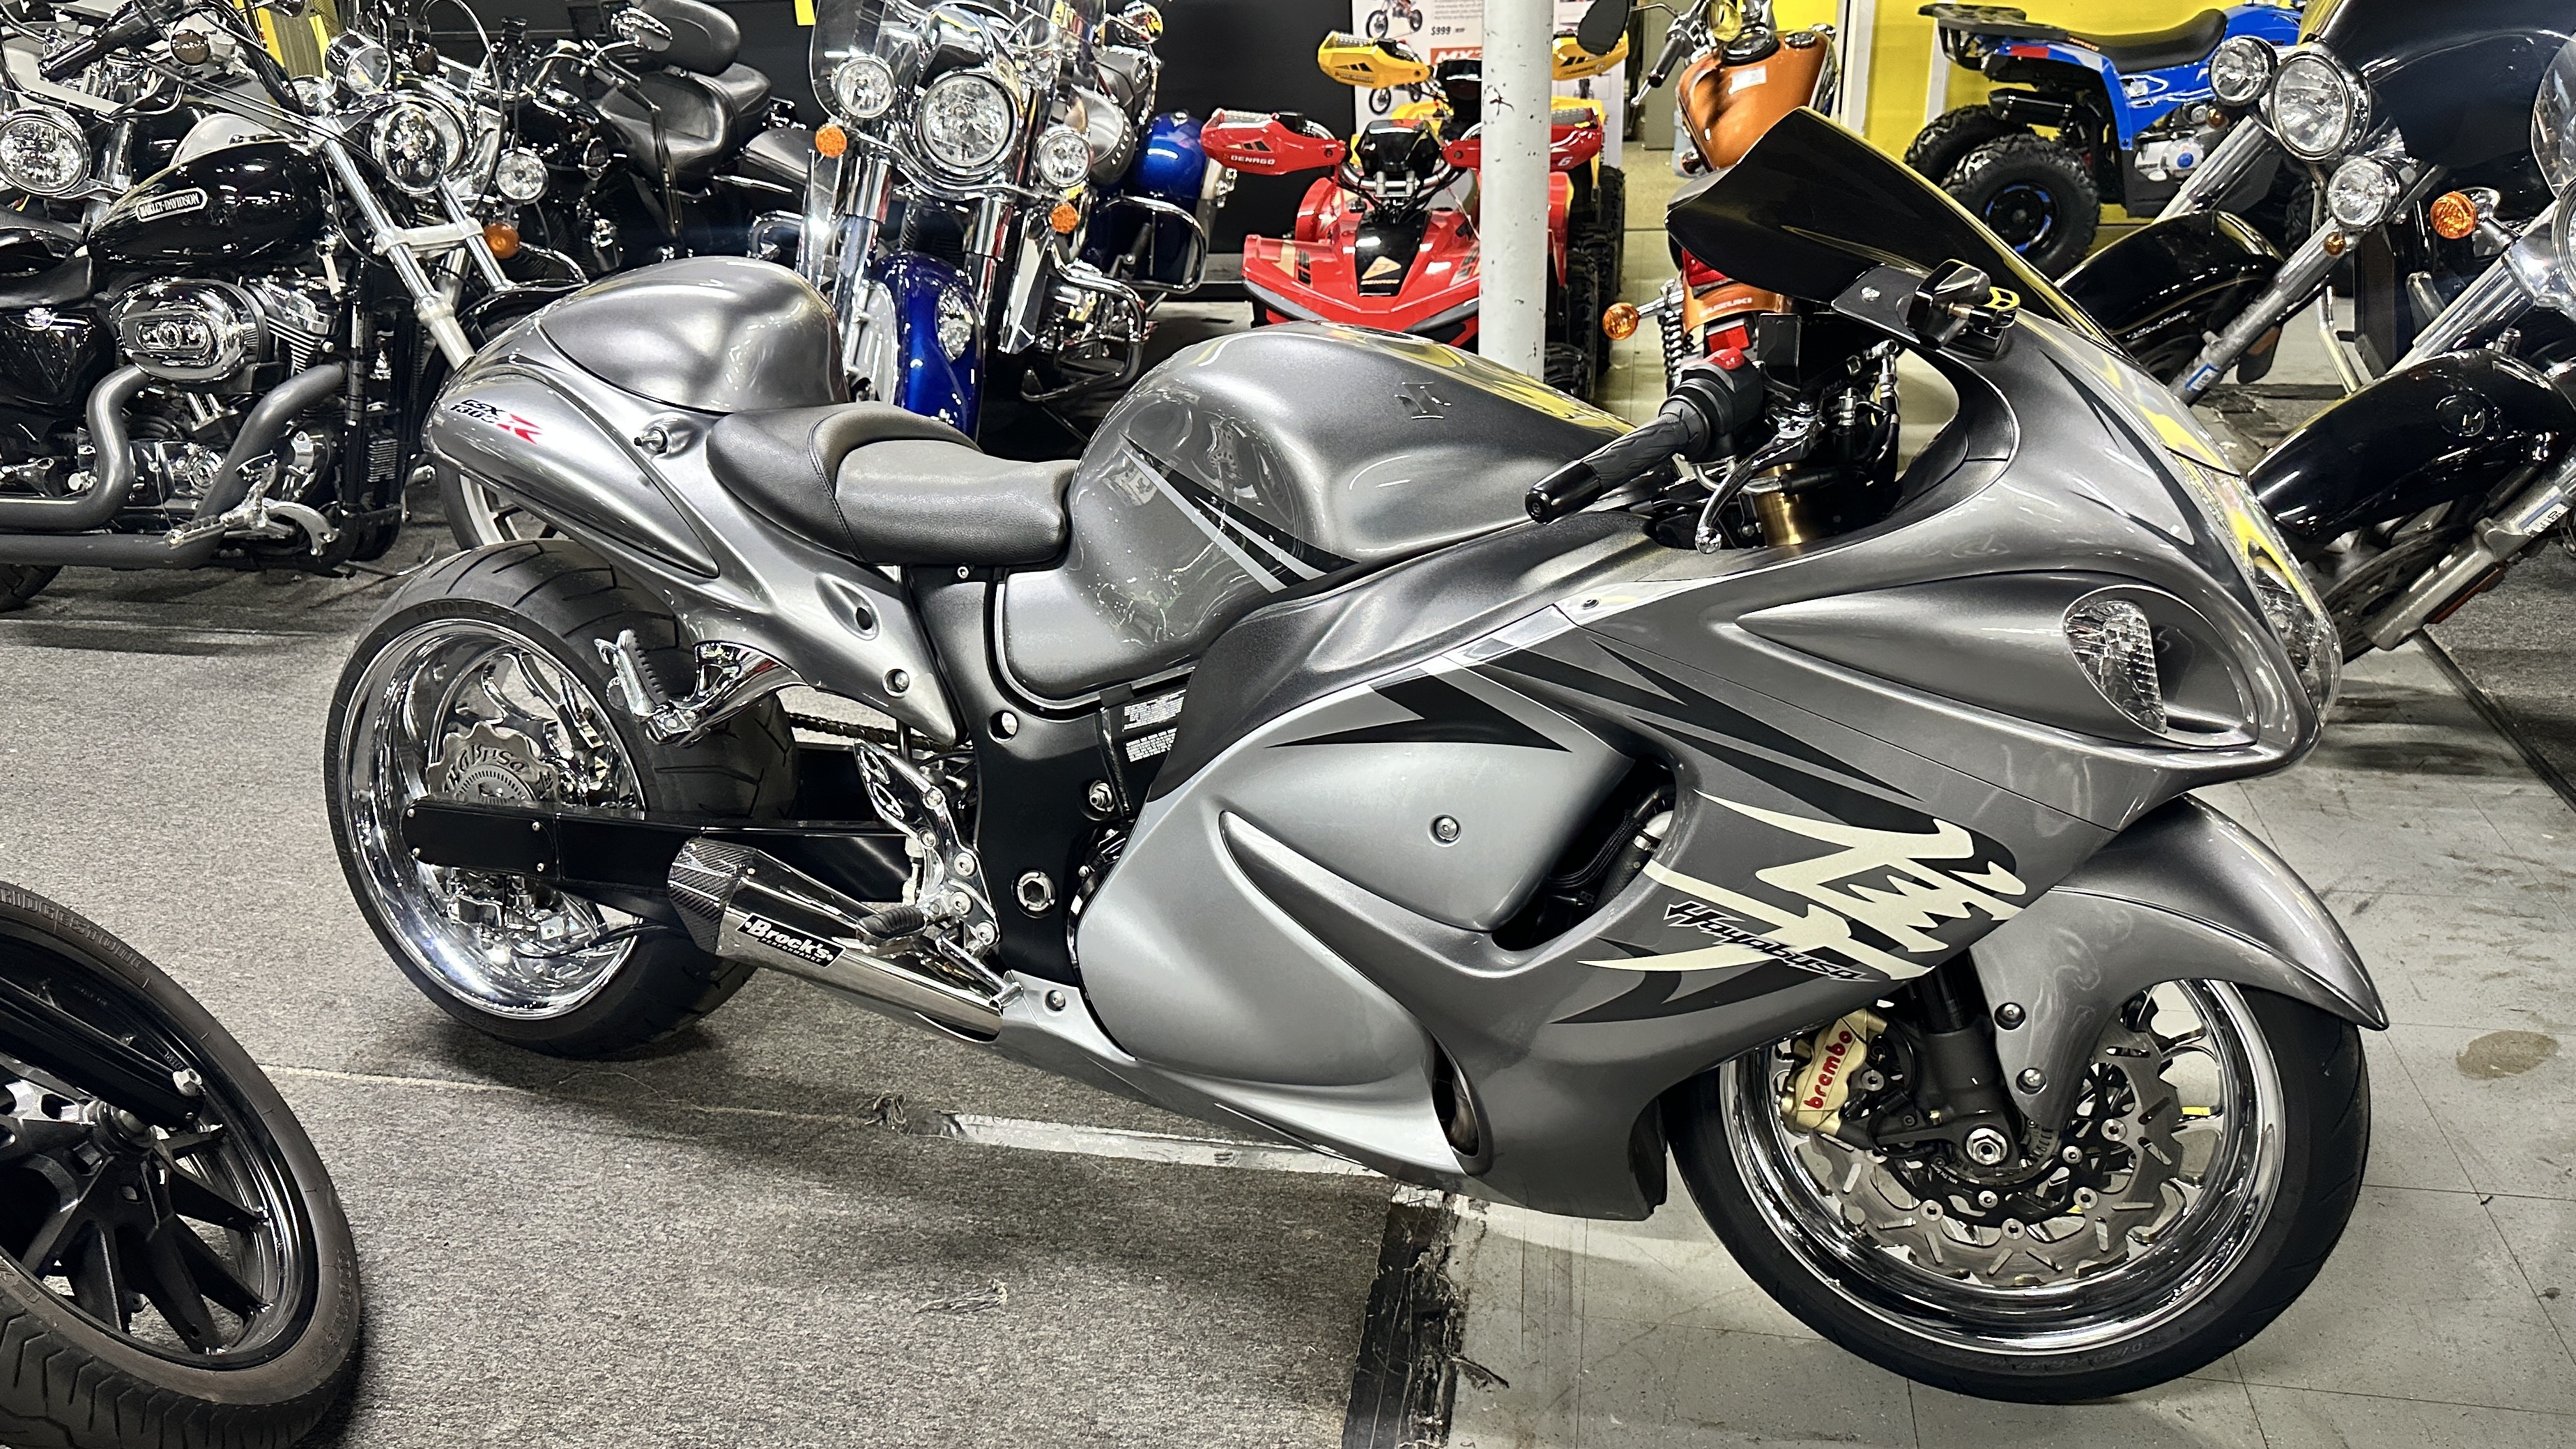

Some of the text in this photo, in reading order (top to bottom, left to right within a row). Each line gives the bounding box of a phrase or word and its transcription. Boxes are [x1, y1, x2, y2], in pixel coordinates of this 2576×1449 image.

[1431, 26, 1451, 35] $999
[1230, 155, 1275, 165] DENAGO
[139, 192, 200, 218] HARLEY-DAVIDSON
[1699, 297, 1752, 318] SUZUKI
[0, 887, 148, 974] RIDGESTONE
[746, 919, 831, 959] Brock's
[1663, 900, 1880, 982] Hayabusa
[761, 937, 823, 963] PERFORMANCE
[1803, 1031, 1853, 1109] brembo
